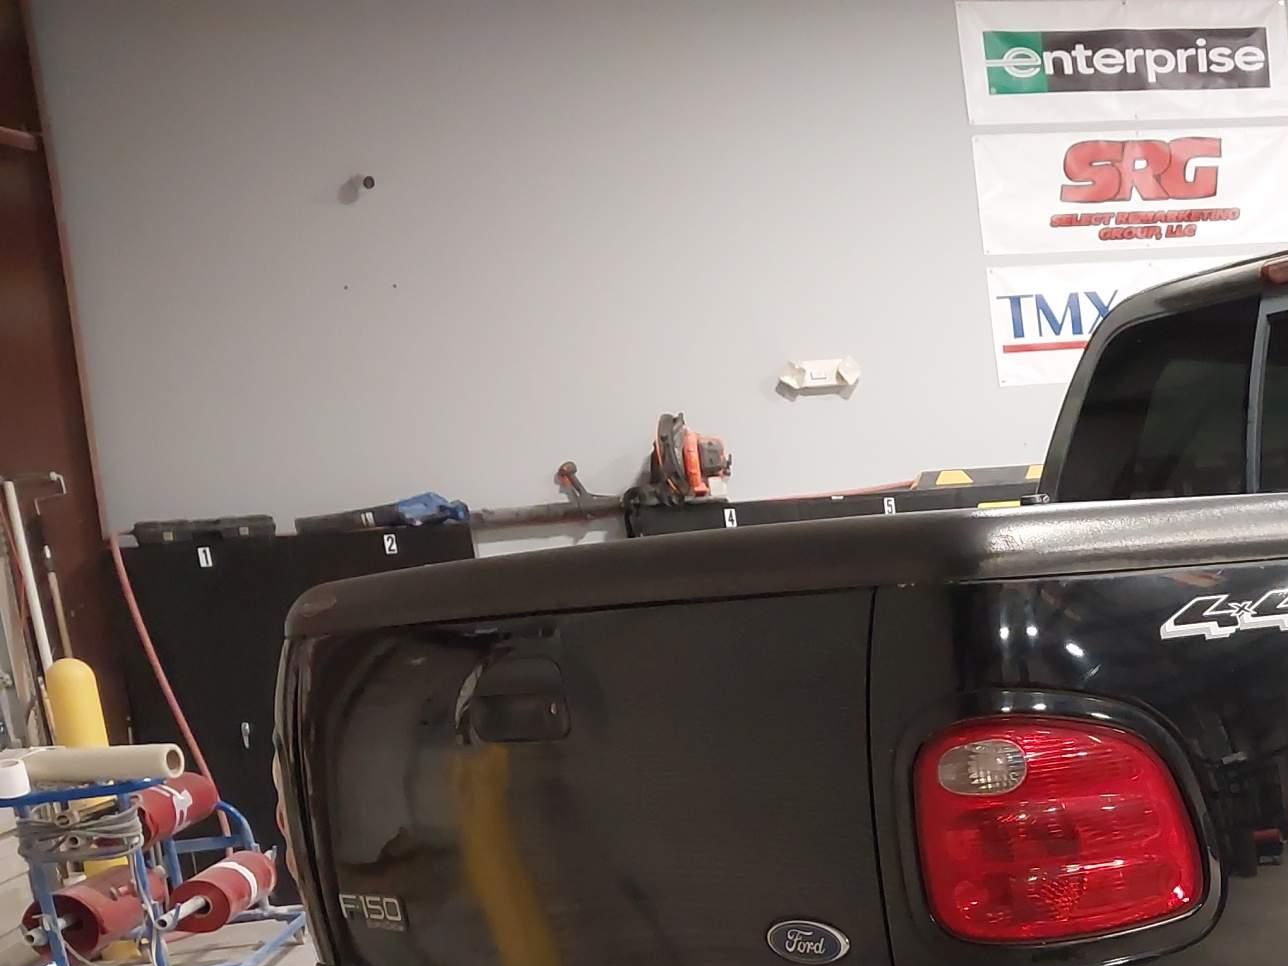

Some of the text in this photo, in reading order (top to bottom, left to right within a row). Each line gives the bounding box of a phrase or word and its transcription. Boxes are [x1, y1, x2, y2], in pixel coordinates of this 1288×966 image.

[1002, 38, 1266, 83] enterprise
[1060, 136, 1223, 204] SRG
[1050, 208, 1241, 228] SELECT REMARKETING
[1165, 224, 1197, 239] LLC
[386, 535, 396, 552] 2
[785, 928, 827, 954] Ford
